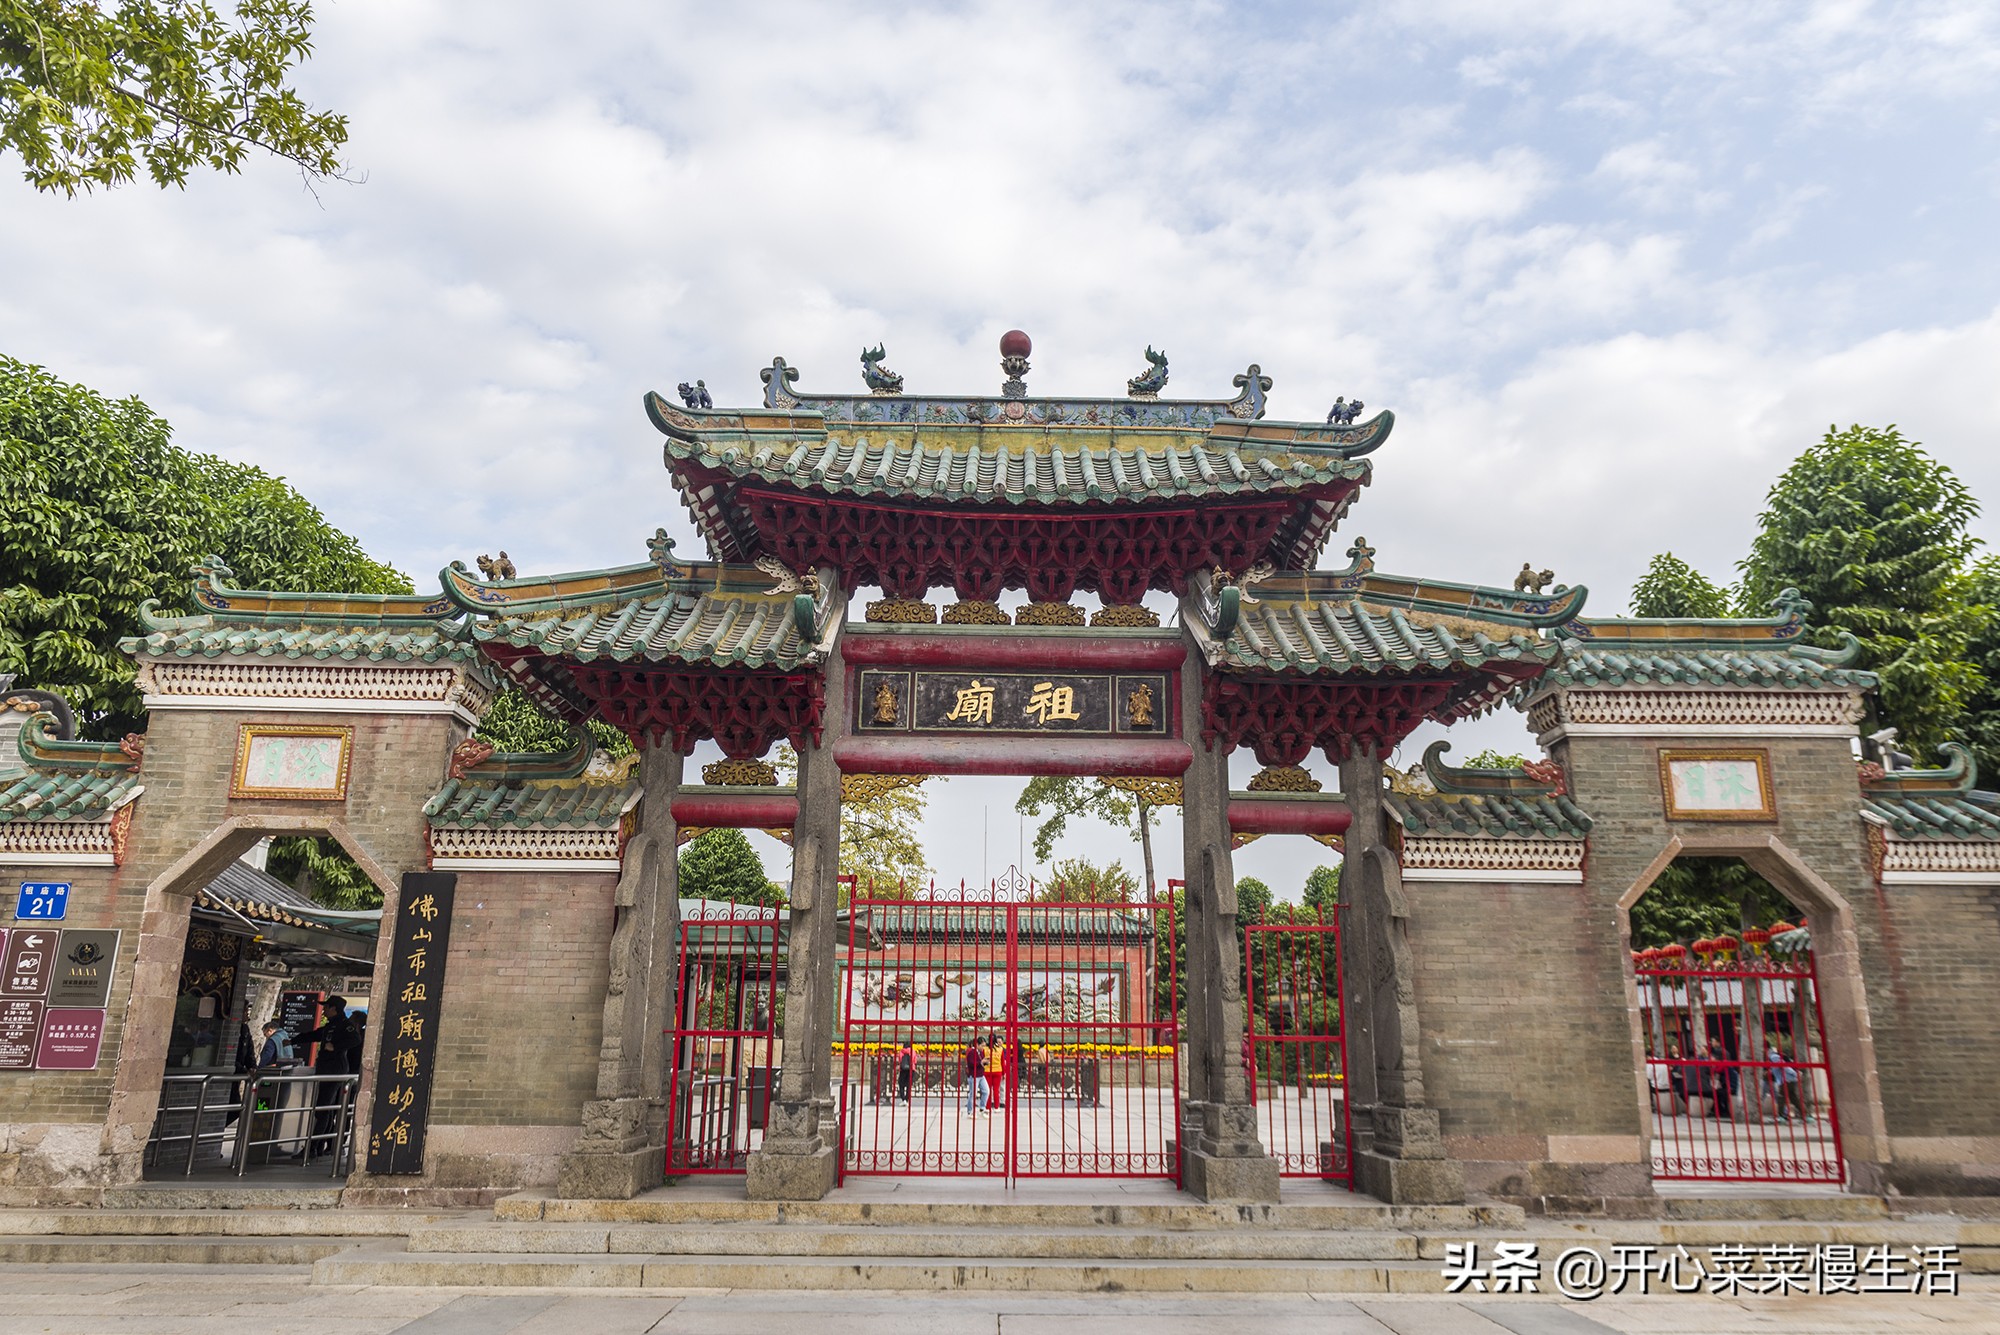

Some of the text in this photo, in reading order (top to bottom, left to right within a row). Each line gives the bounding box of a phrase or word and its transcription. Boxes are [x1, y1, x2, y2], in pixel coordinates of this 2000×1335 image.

[25, 886, 65, 895] 祖庙路
[30, 897, 54, 915] 21
[12, 977, 39, 986] 售票处
